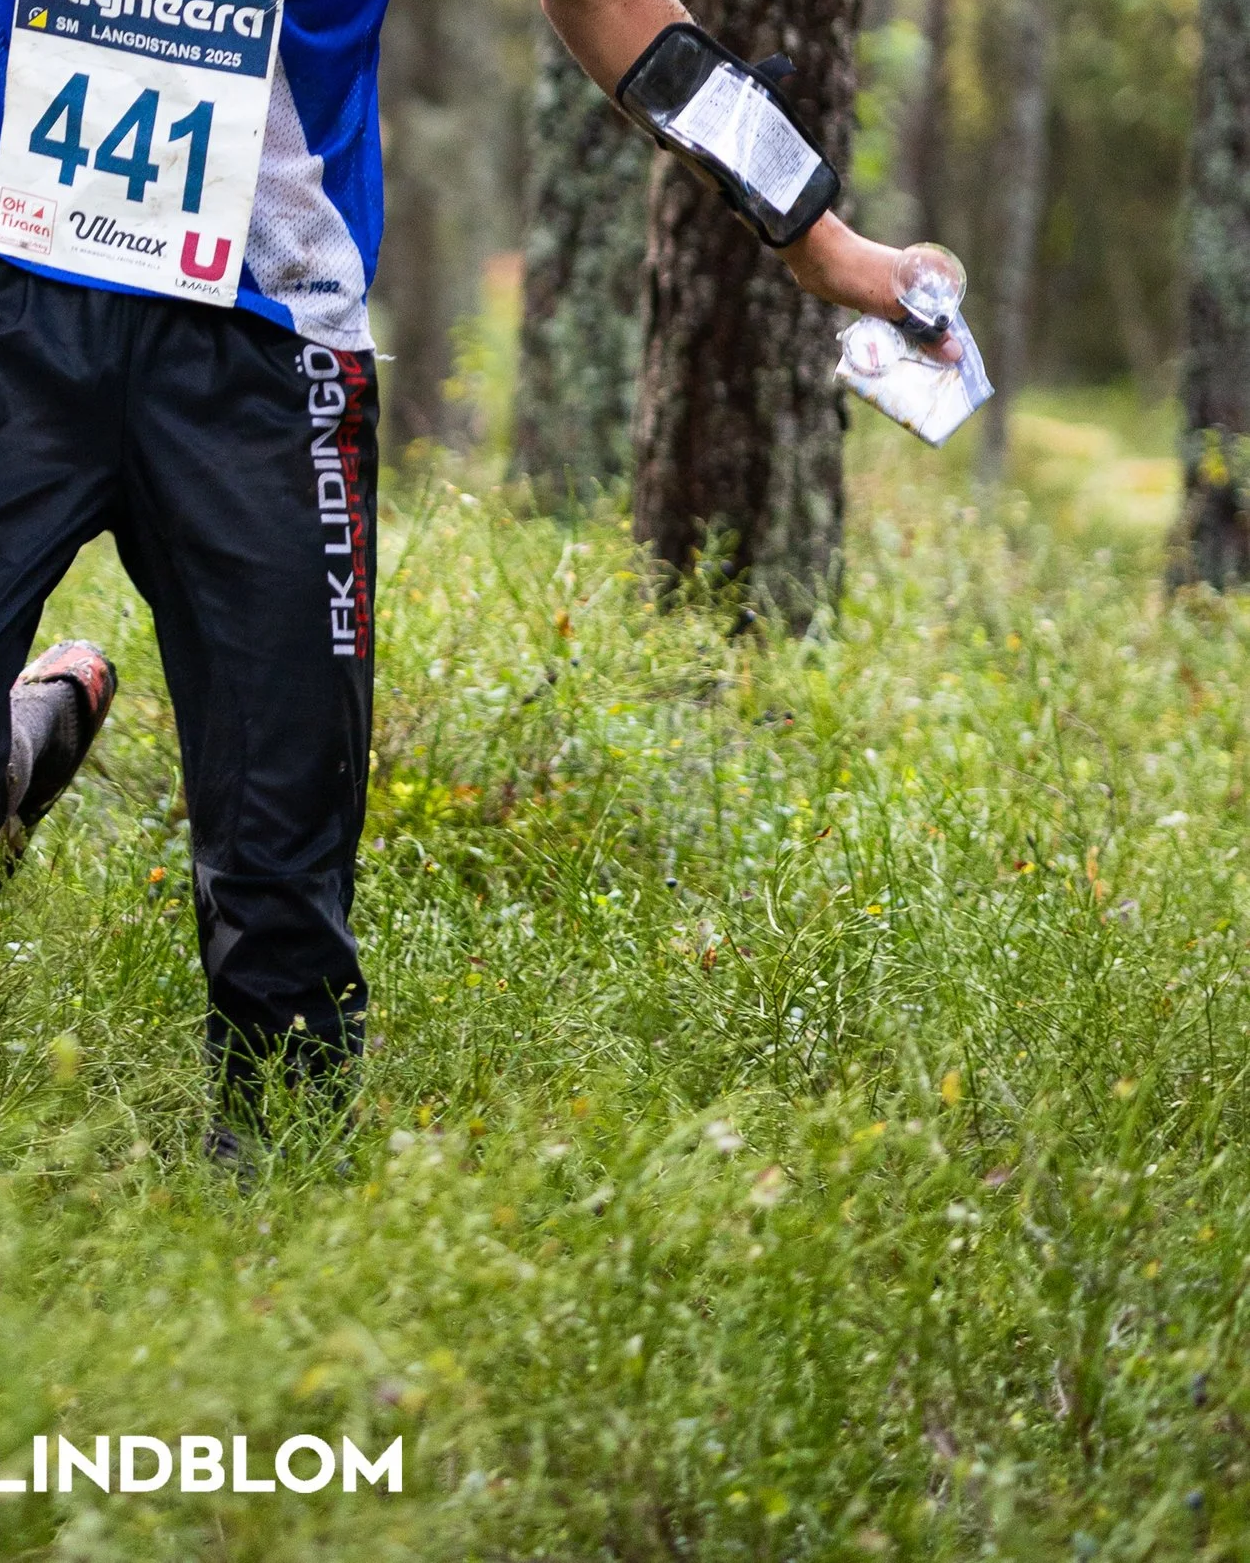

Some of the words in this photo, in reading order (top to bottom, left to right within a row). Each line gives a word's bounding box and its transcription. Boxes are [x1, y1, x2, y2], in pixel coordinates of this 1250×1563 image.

[55, 16, 80, 35] SM
[204, 47, 243, 68] 2025
[28, 72, 215, 215] 441
[1, 213, 51, 238] Tisaren
[69, 210, 168, 257] Ullmax
[180, 230, 231, 282] U
[308, 280, 340, 295] 1932
[295, 343, 352, 554] LIDINGÖ
[327, 570, 356, 656] IFK
